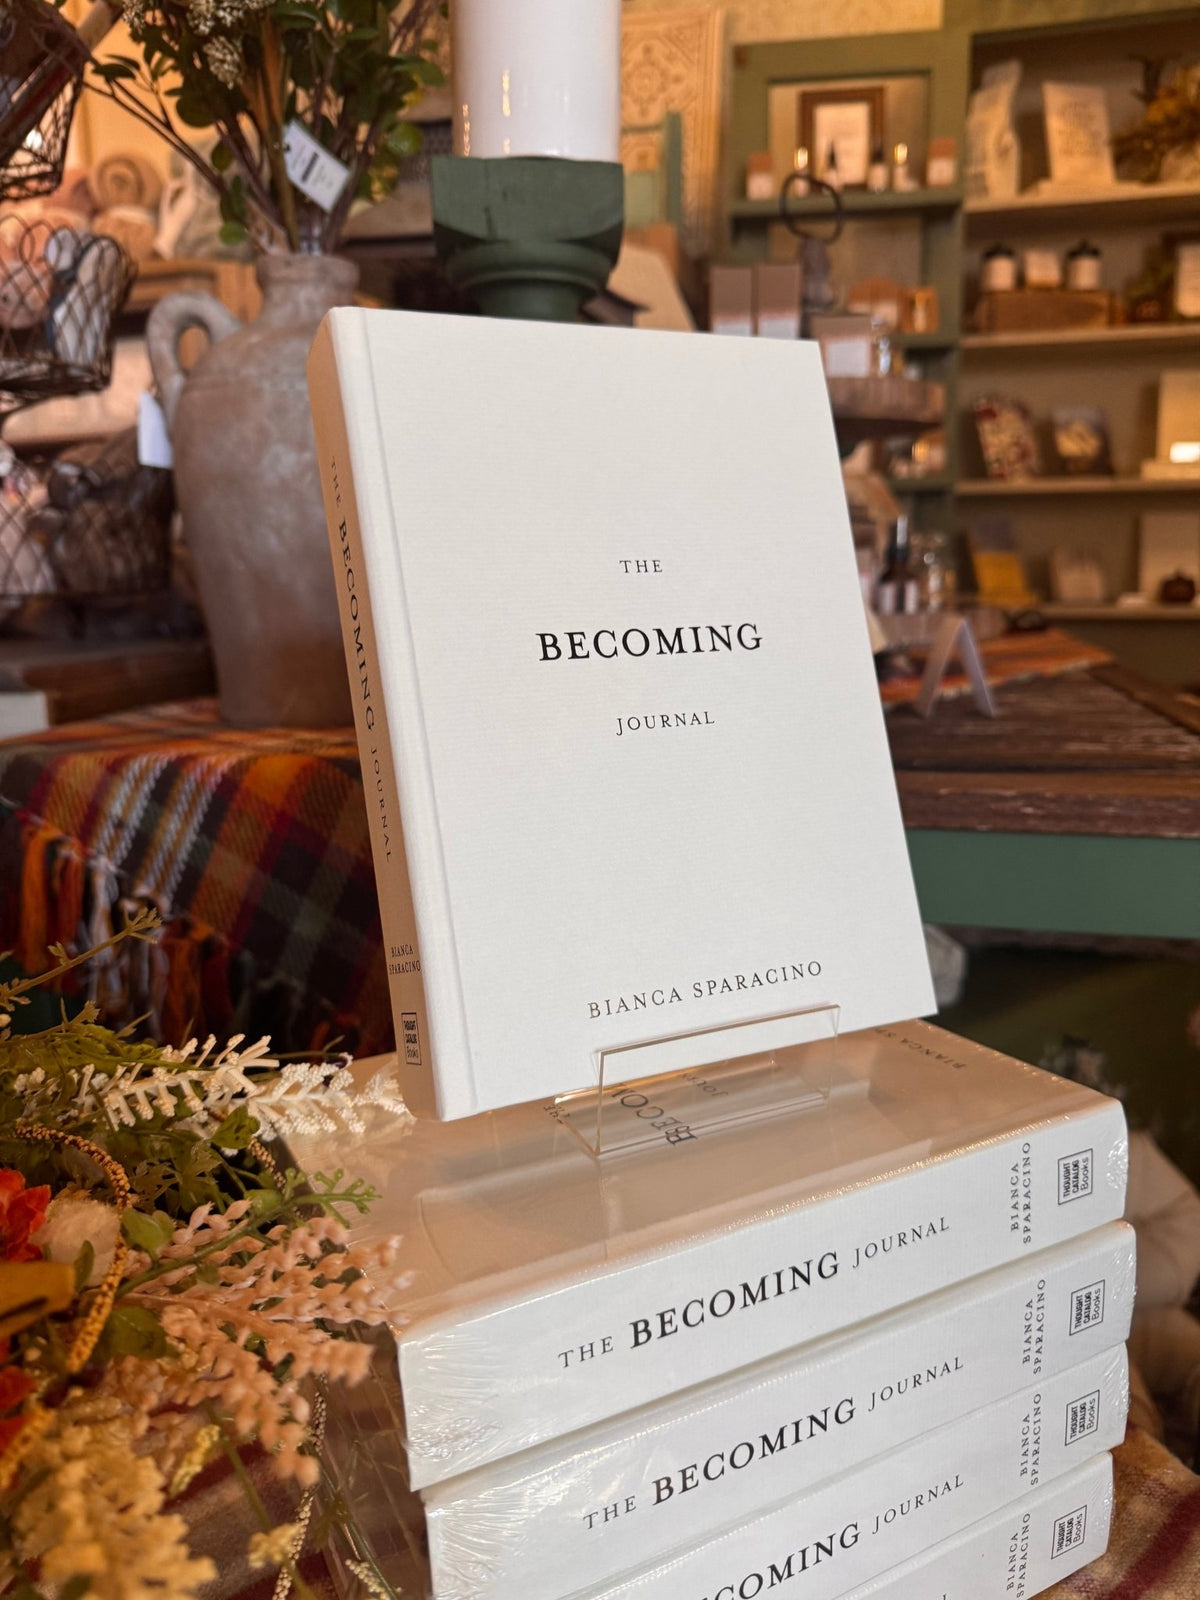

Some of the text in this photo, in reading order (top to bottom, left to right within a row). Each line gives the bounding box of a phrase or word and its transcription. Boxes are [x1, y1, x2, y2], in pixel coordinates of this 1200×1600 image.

[619, 559, 663, 574] THE
[535, 622, 763, 661] BECOMING
[339, 516, 375, 730] BECOMING
[371, 745, 392, 863] JOURNAL
[616, 711, 715, 736] JOURNAL
[391, 944, 413, 957] BIANCA
[588, 960, 822, 1019] BIANCA SPARACINO
[1010, 1162, 1019, 1232] BIANCA
[1022, 1142, 1031, 1244] SPARACINO
[1063, 1162, 1071, 1198] THOUGHT
[1080, 1157, 1088, 1190] Books
[558, 1217, 950, 1368] THE BECOMING JOURNAL
[1075, 1295, 1083, 1329] THOUGHT
[1083, 1291, 1091, 1324] CATALOG
[1092, 1288, 1100, 1320] Books
[1022, 1299, 1033, 1365] BIANCA
[1033, 1279, 1046, 1375] SPARACINO
[1070, 1405, 1078, 1440] THOUGHT
[1087, 1398, 1095, 1430] Books
[583, 1357, 964, 1530] THE BECOMING JOURNAL
[1020, 1413, 1030, 1476] BIANCA
[1030, 1393, 1042, 1485] SPARACINO
[701, 1474, 964, 1600] COMING JOURNAL
[1057, 1521, 1065, 1552] THOUGHT
[1073, 1513, 1082, 1542] Books
[1007, 1533, 1018, 1591] BIANCA
[1016, 1513, 1031, 1598] SPARACINO
